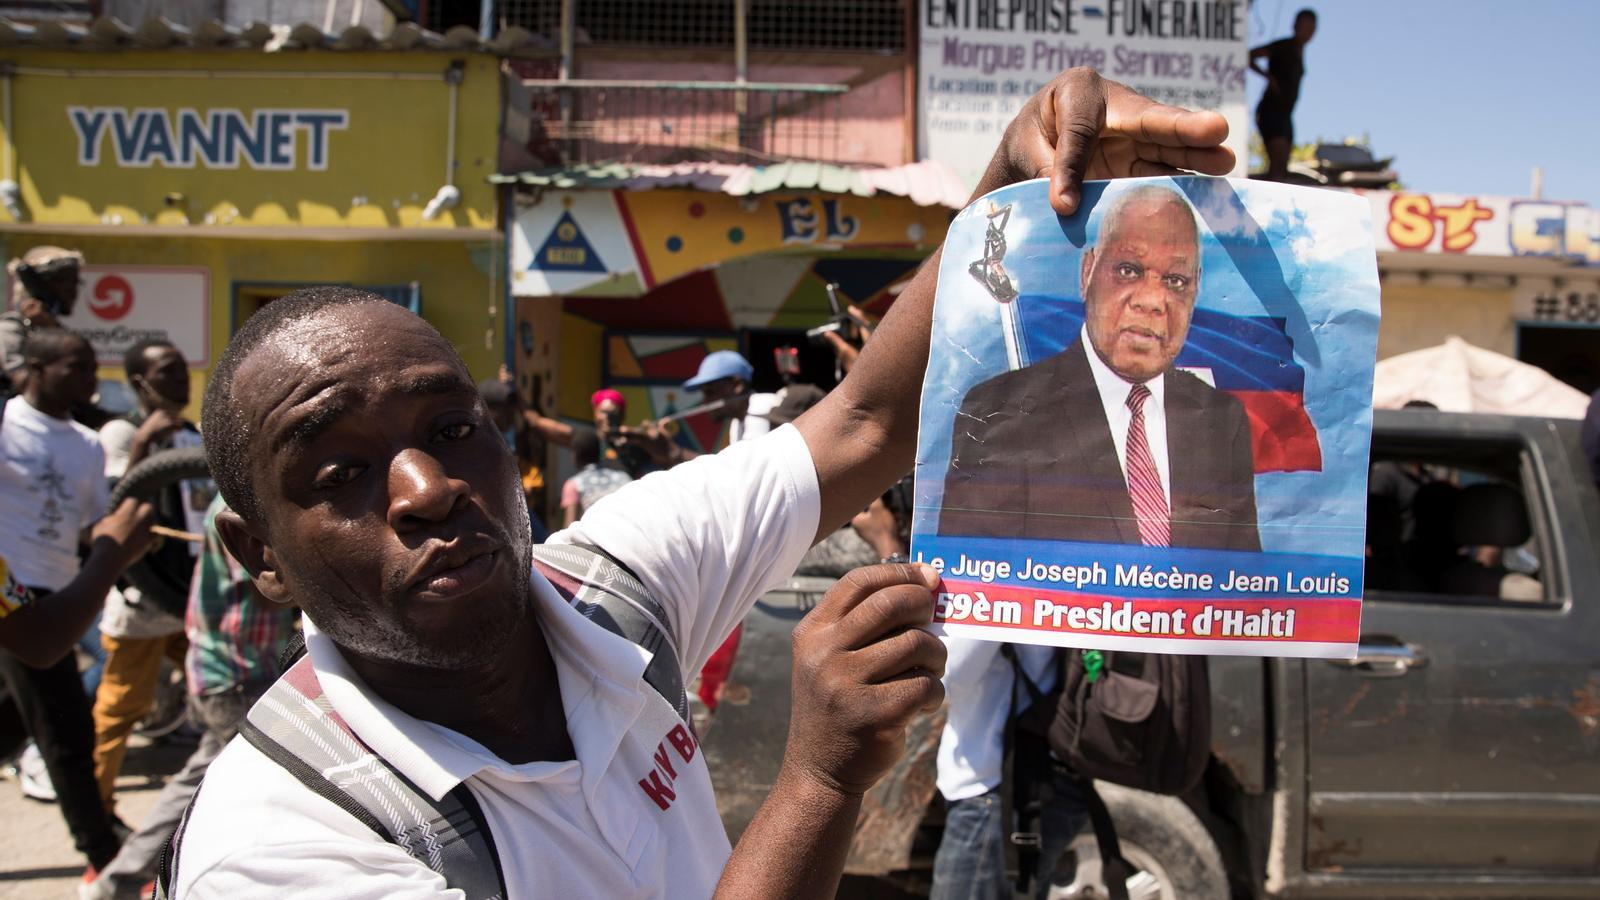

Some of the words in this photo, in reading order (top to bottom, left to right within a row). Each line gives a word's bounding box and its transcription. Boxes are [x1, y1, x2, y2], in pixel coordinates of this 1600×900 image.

[926, 0, 1079, 34] ENTREPRISE
[1106, 0, 1245, 41] FUNERAIRE
[943, 36, 1026, 75] Morgue
[1113, 43, 1194, 79] Service
[928, 76, 998, 94] Location
[1002, 78, 1021, 95] de
[67, 107, 348, 170] YVANNET
[1387, 193, 1494, 253] St
[951, 554, 1011, 583] Juge
[1017, 558, 1108, 589] Joseph
[1114, 564, 1213, 591] Mécène
[1219, 570, 1279, 593] Jean
[1286, 572, 1350, 594] Louis
[935, 591, 1022, 625] 59èm
[1033, 599, 1187, 636] President
[1191, 605, 1296, 637] d'Haiti
